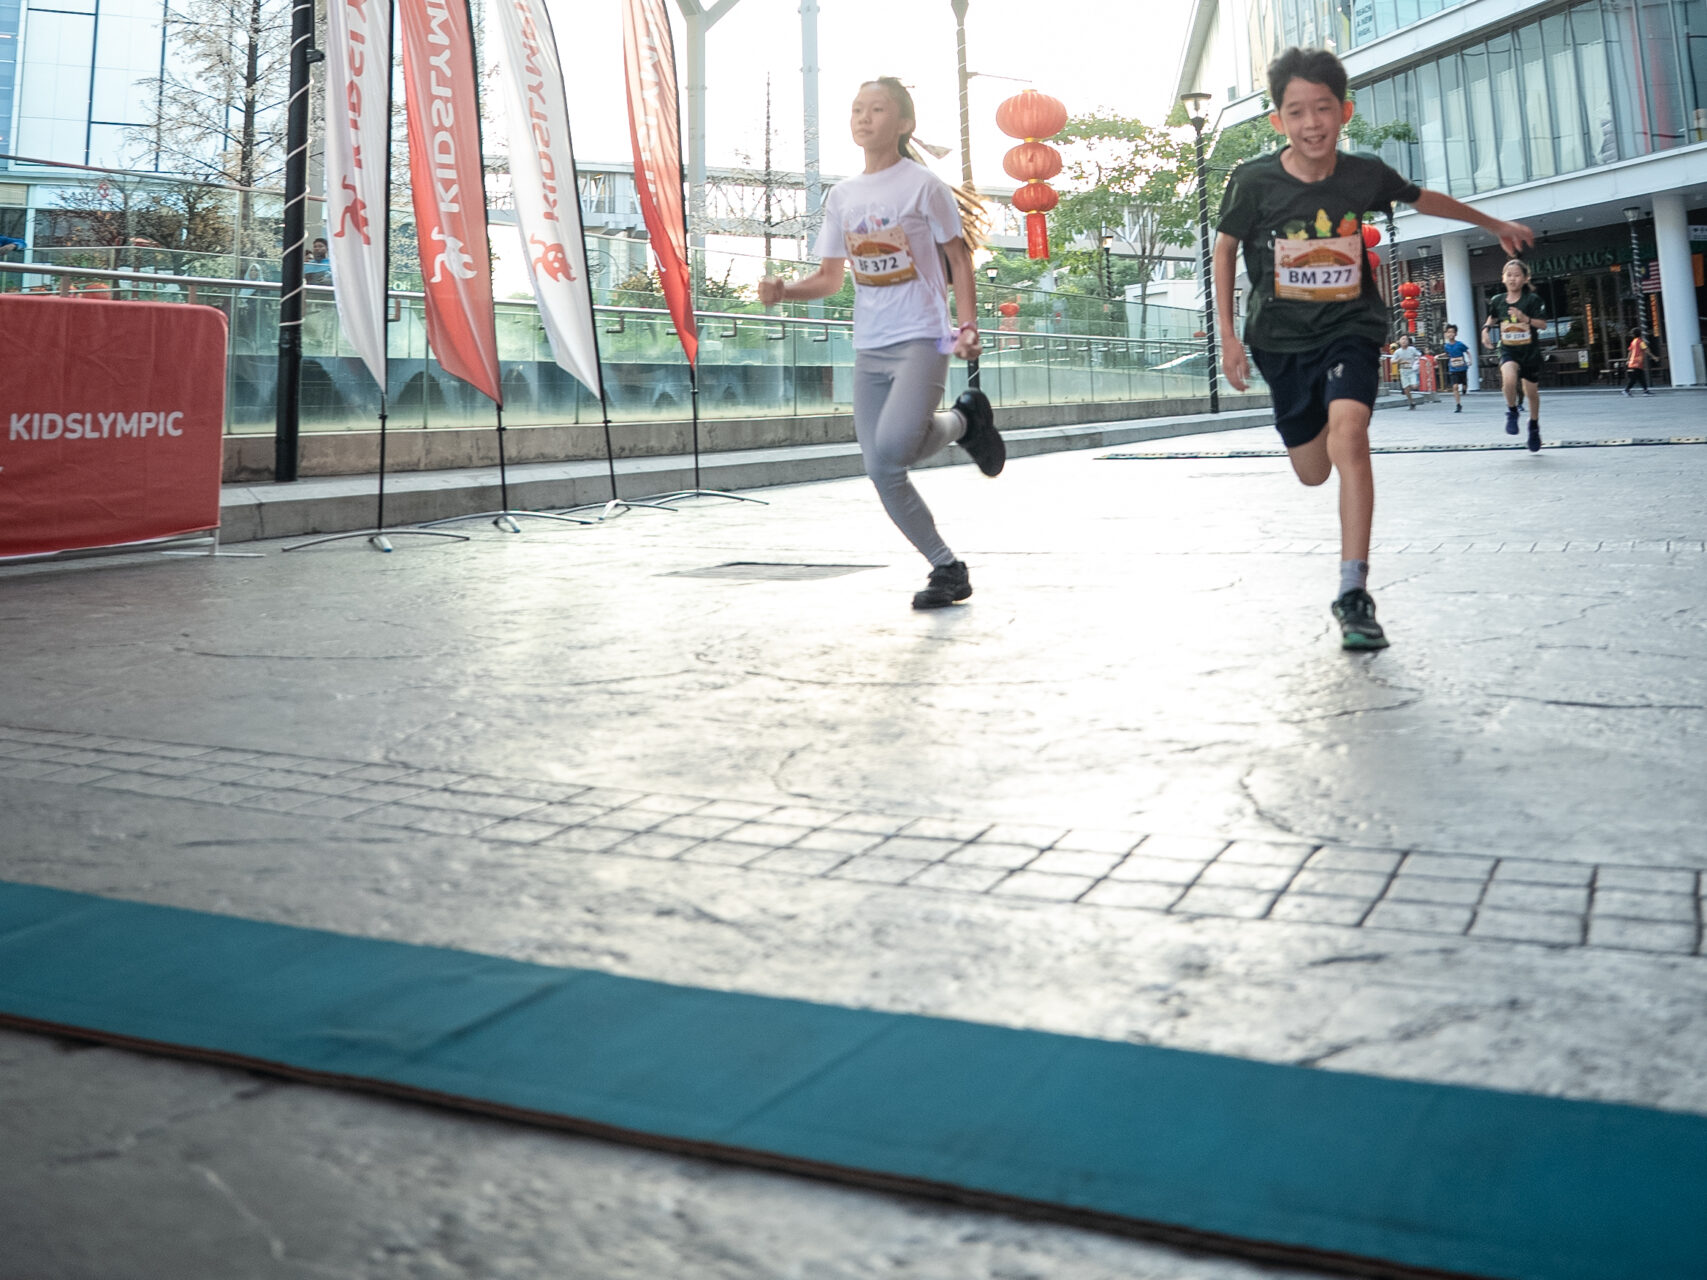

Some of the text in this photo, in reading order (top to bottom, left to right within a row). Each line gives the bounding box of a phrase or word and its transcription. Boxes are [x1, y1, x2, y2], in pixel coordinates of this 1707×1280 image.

[871, 256, 899, 272] 372
[1289, 268, 1352, 285] BM 277
[9, 411, 184, 441] KIDSLYMPIC
